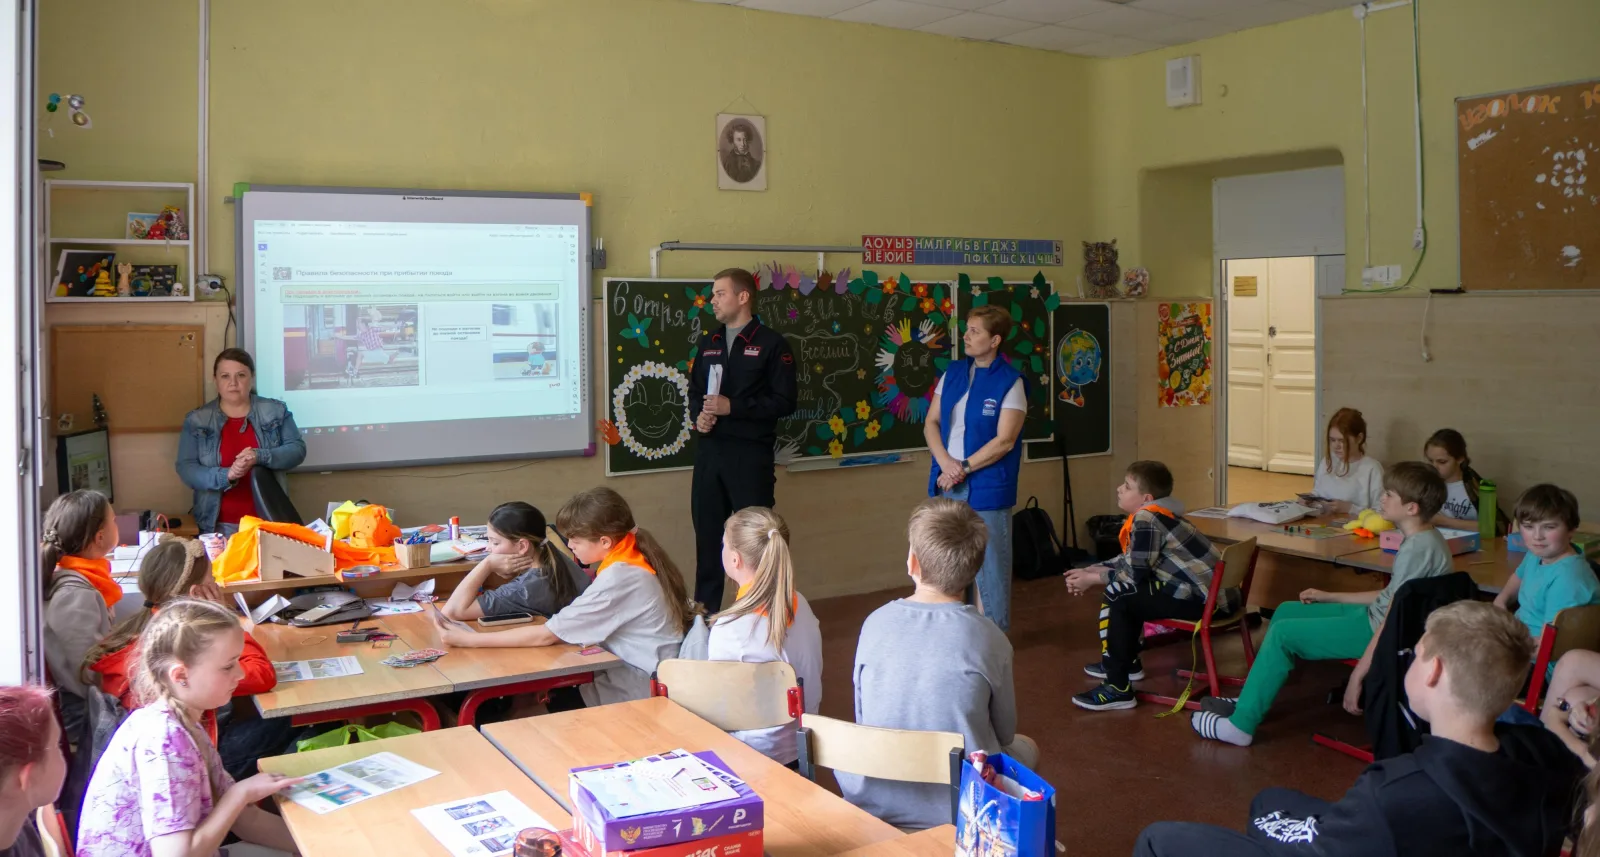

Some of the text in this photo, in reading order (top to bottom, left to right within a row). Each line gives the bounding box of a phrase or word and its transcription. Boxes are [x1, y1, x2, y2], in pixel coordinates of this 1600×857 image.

[296, 269, 327, 278] Правила
[329, 269, 378, 277] безопасности
[380, 270, 392, 278] при
